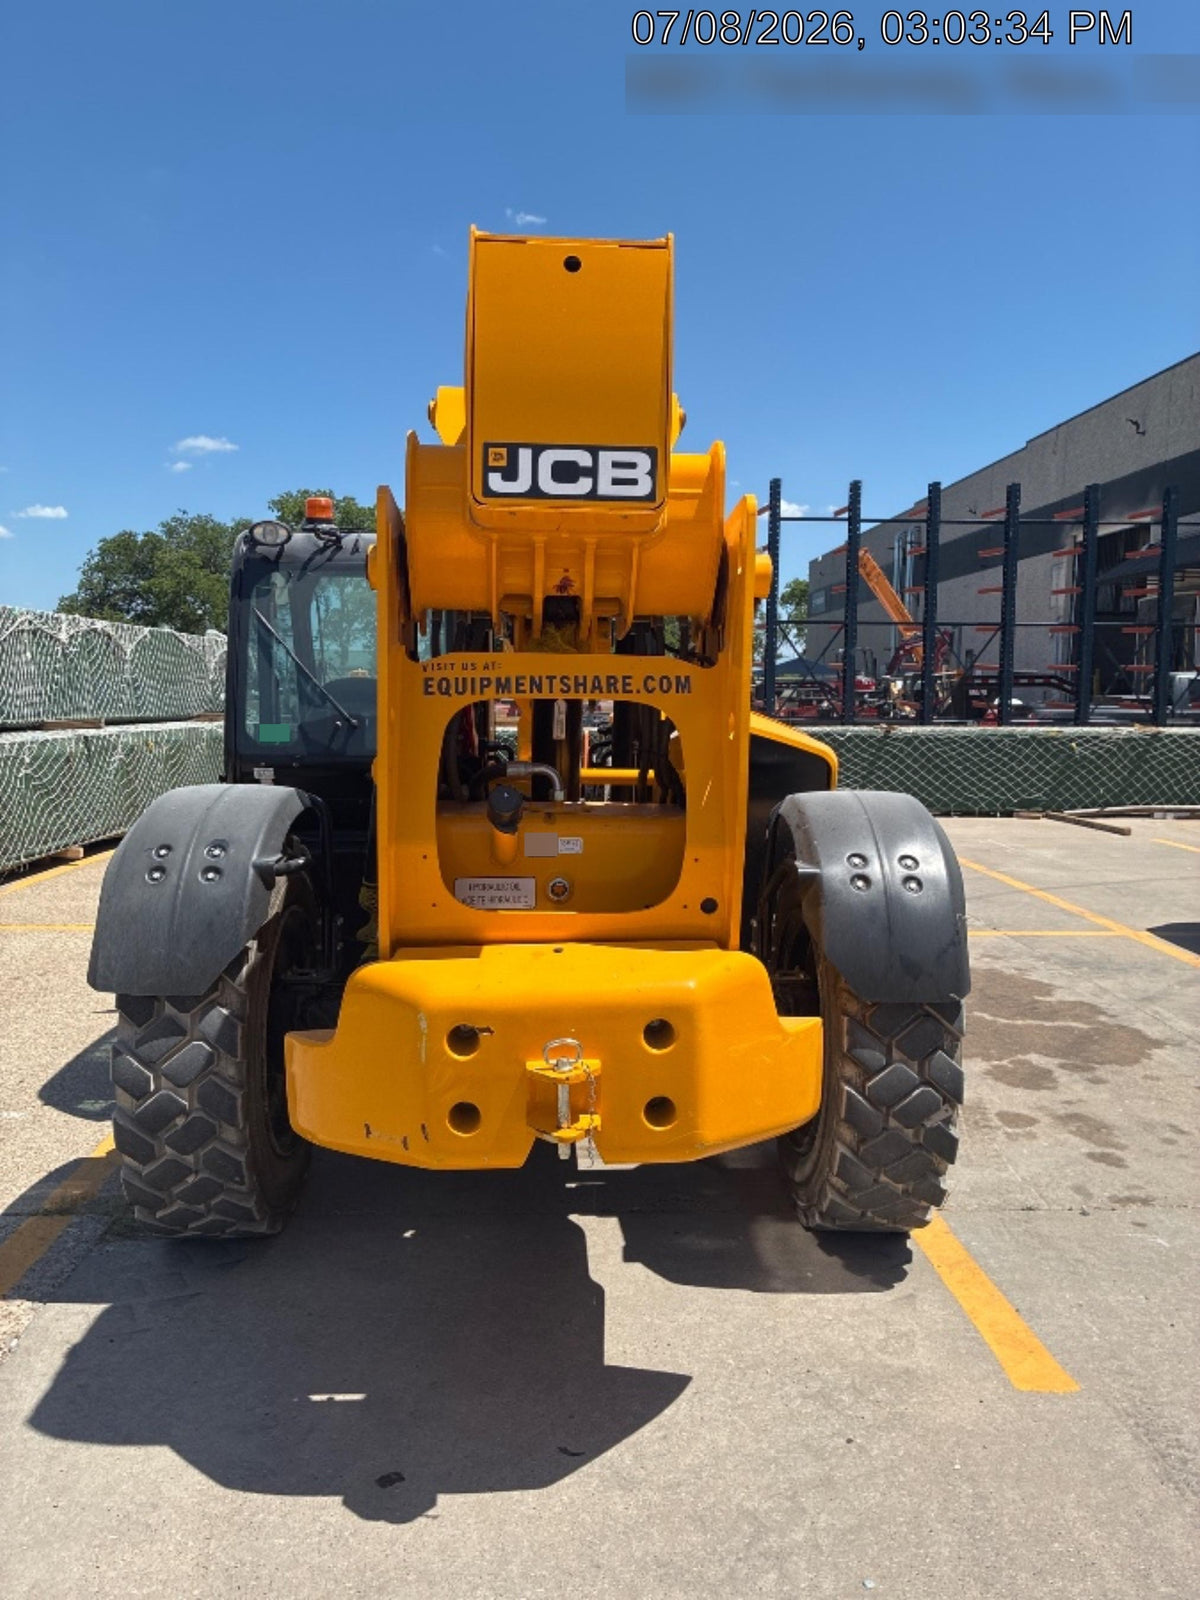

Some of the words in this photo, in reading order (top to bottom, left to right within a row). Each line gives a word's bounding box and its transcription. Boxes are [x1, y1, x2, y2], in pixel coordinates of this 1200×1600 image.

[488, 447, 653, 497] JCB
[421, 662, 456, 672] VISIT
[461, 662, 478, 671] US
[422, 675, 692, 697] EQUIPMENTSHARE.COM
